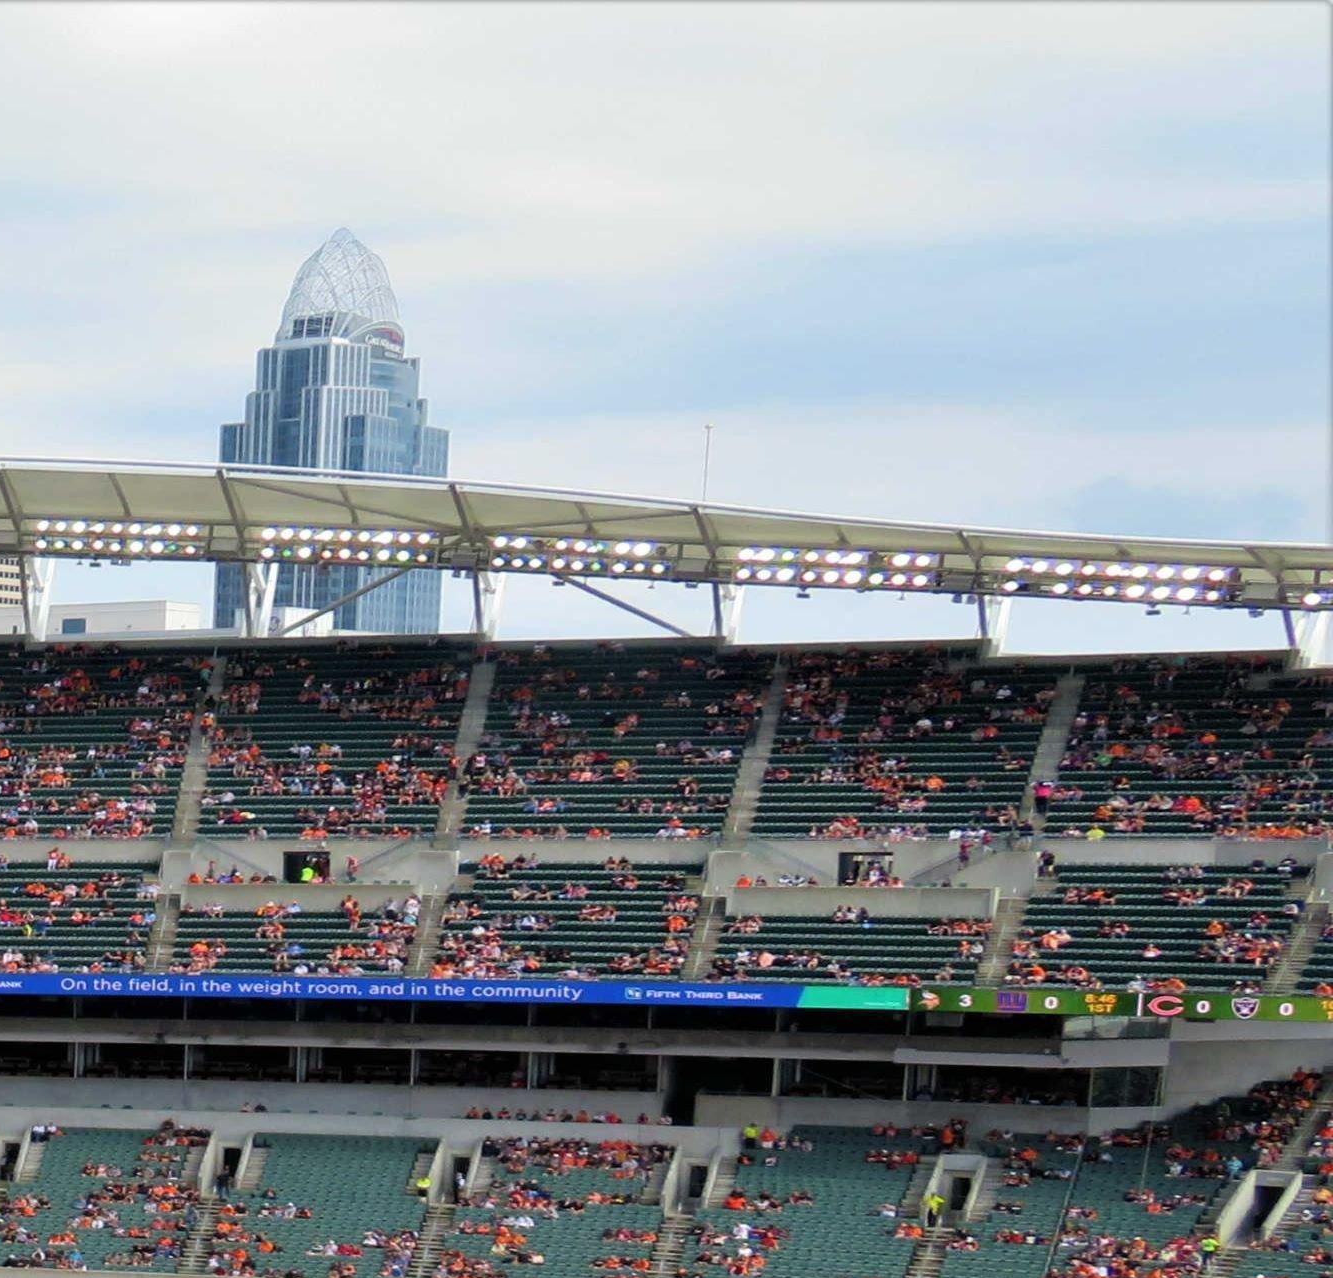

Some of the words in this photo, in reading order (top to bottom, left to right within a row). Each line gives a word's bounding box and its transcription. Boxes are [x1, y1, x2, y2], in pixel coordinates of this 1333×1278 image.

[60, 978, 87, 991] On
[92, 978, 122, 991] the
[128, 978, 173, 993] field,
[179, 978, 196, 992] in
[201, 979, 231, 993] the
[236, 980, 301, 996] weight
[307, 982, 362, 997] room,
[369, 981, 405, 996] and
[411, 982, 429, 996] in
[434, 982, 466, 997] the
[471, 985, 583, 1002] community
[646, 990, 681, 999] FIFTH
[685, 990, 723, 999] THIRD
[727, 991, 764, 1001] BANK
[958, 994, 972, 1007] 3
